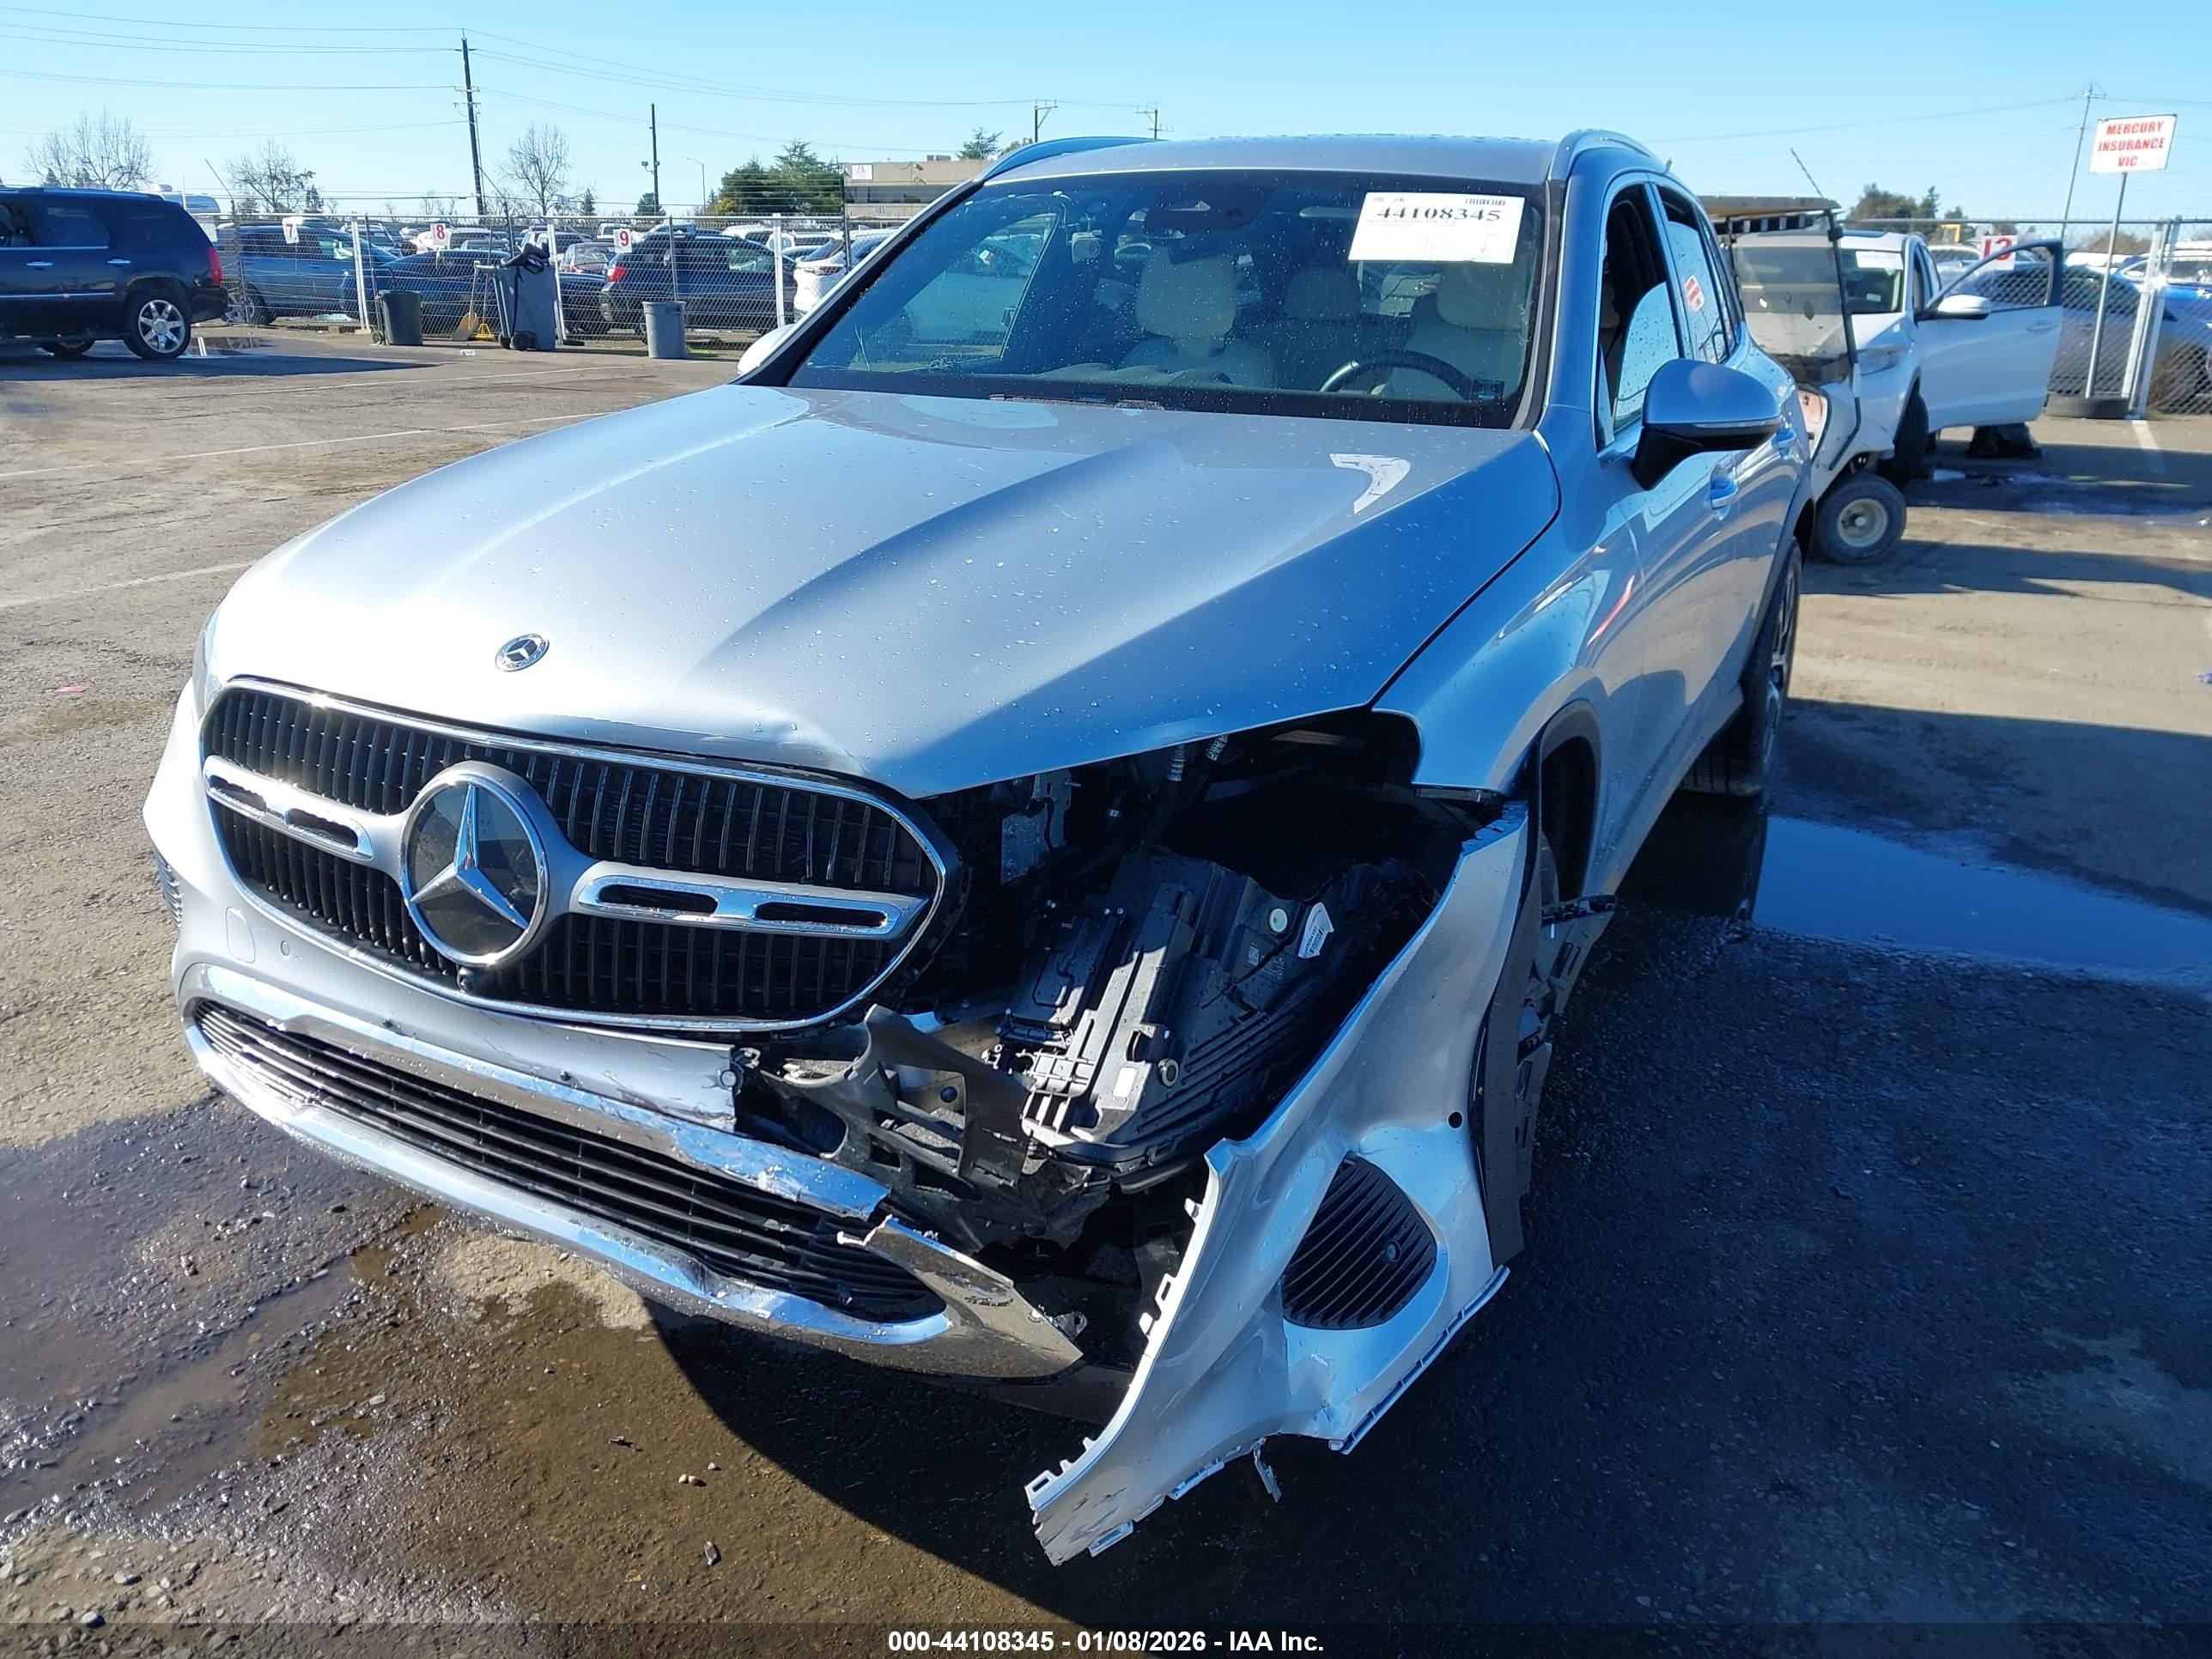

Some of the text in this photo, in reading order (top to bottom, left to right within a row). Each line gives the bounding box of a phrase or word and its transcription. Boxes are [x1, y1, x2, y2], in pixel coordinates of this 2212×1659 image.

[2106, 121, 2164, 136] MERCURY
[2098, 137, 2166, 152] INSURANCE
[2118, 155, 2138, 167] VIC
[1376, 207, 1502, 222] 44108345
[285, 223, 294, 239] 7
[435, 224, 446, 240] 8
[619, 230, 630, 246] 9
